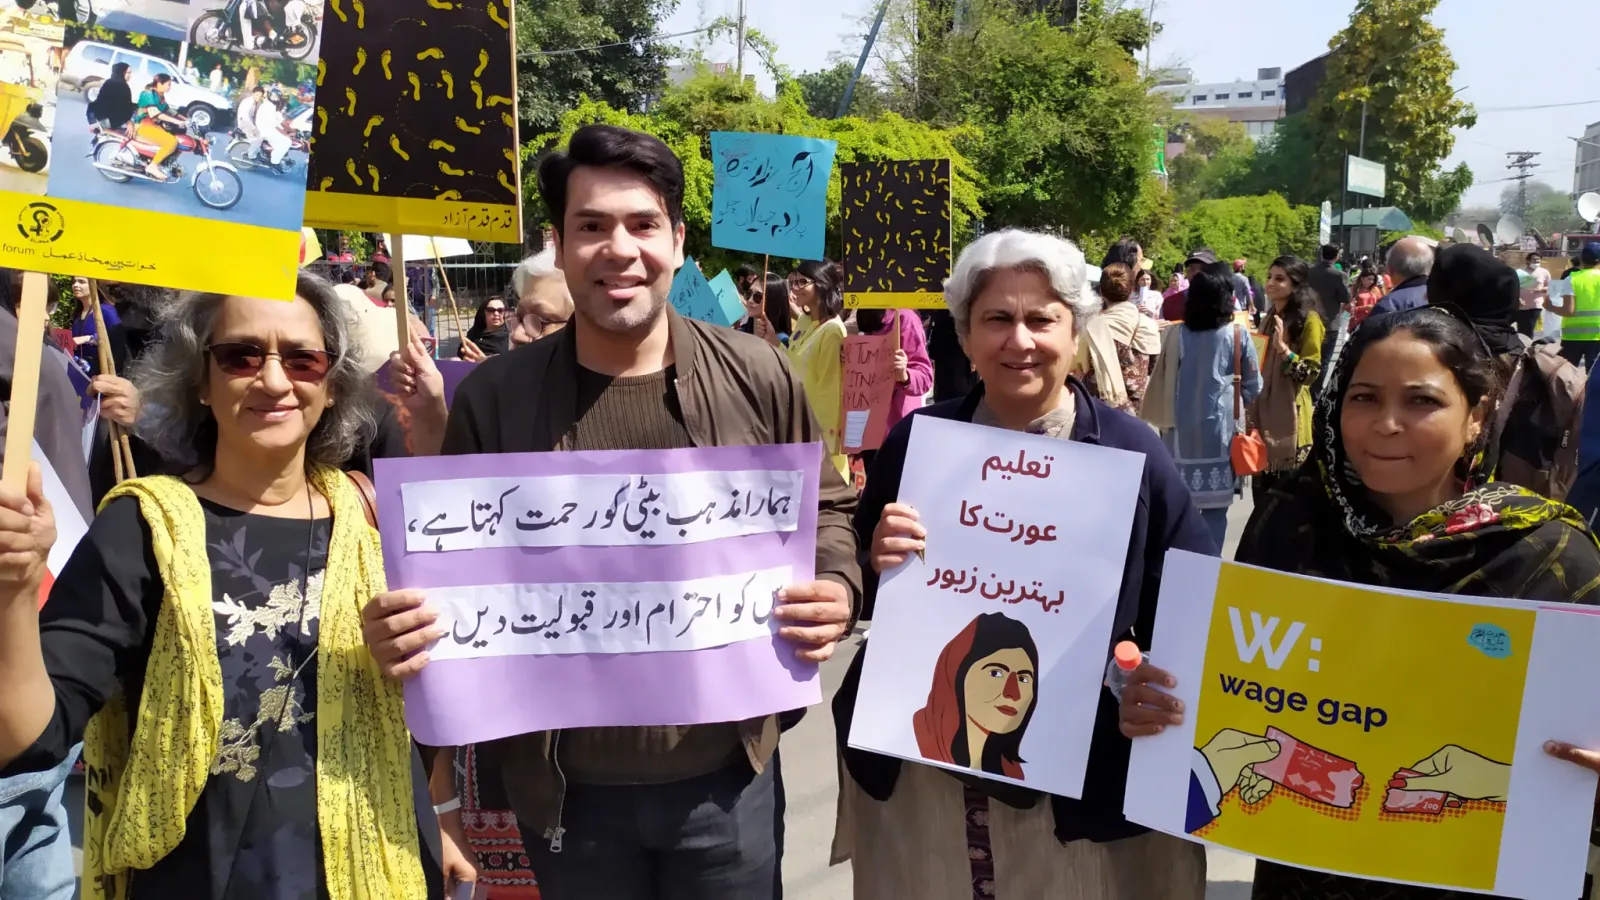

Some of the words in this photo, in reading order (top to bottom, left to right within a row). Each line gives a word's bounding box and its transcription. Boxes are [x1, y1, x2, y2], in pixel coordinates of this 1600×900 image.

[2, 242, 36, 256] forum
[41, 247, 77, 260] عمل
[981, 449, 1055, 481] تعلیم
[470, 484, 521, 537] کہتا
[516, 500, 598, 532] رحمت
[601, 483, 633, 531] کو
[622, 475, 661, 539] بیٹی
[665, 488, 742, 538] مذہب
[744, 486, 791, 518] ہمارا
[959, 499, 983, 527] کا
[982, 511, 1057, 545] عورت
[926, 566, 978, 594] زیور
[980, 573, 1065, 614] بہترین
[510, 589, 597, 641] قبولیت
[602, 598, 641, 631] اور
[645, 590, 723, 645] احترام
[729, 573, 757, 625] کو
[1219, 672, 1308, 714] wage
[1316, 697, 1388, 733] gap
